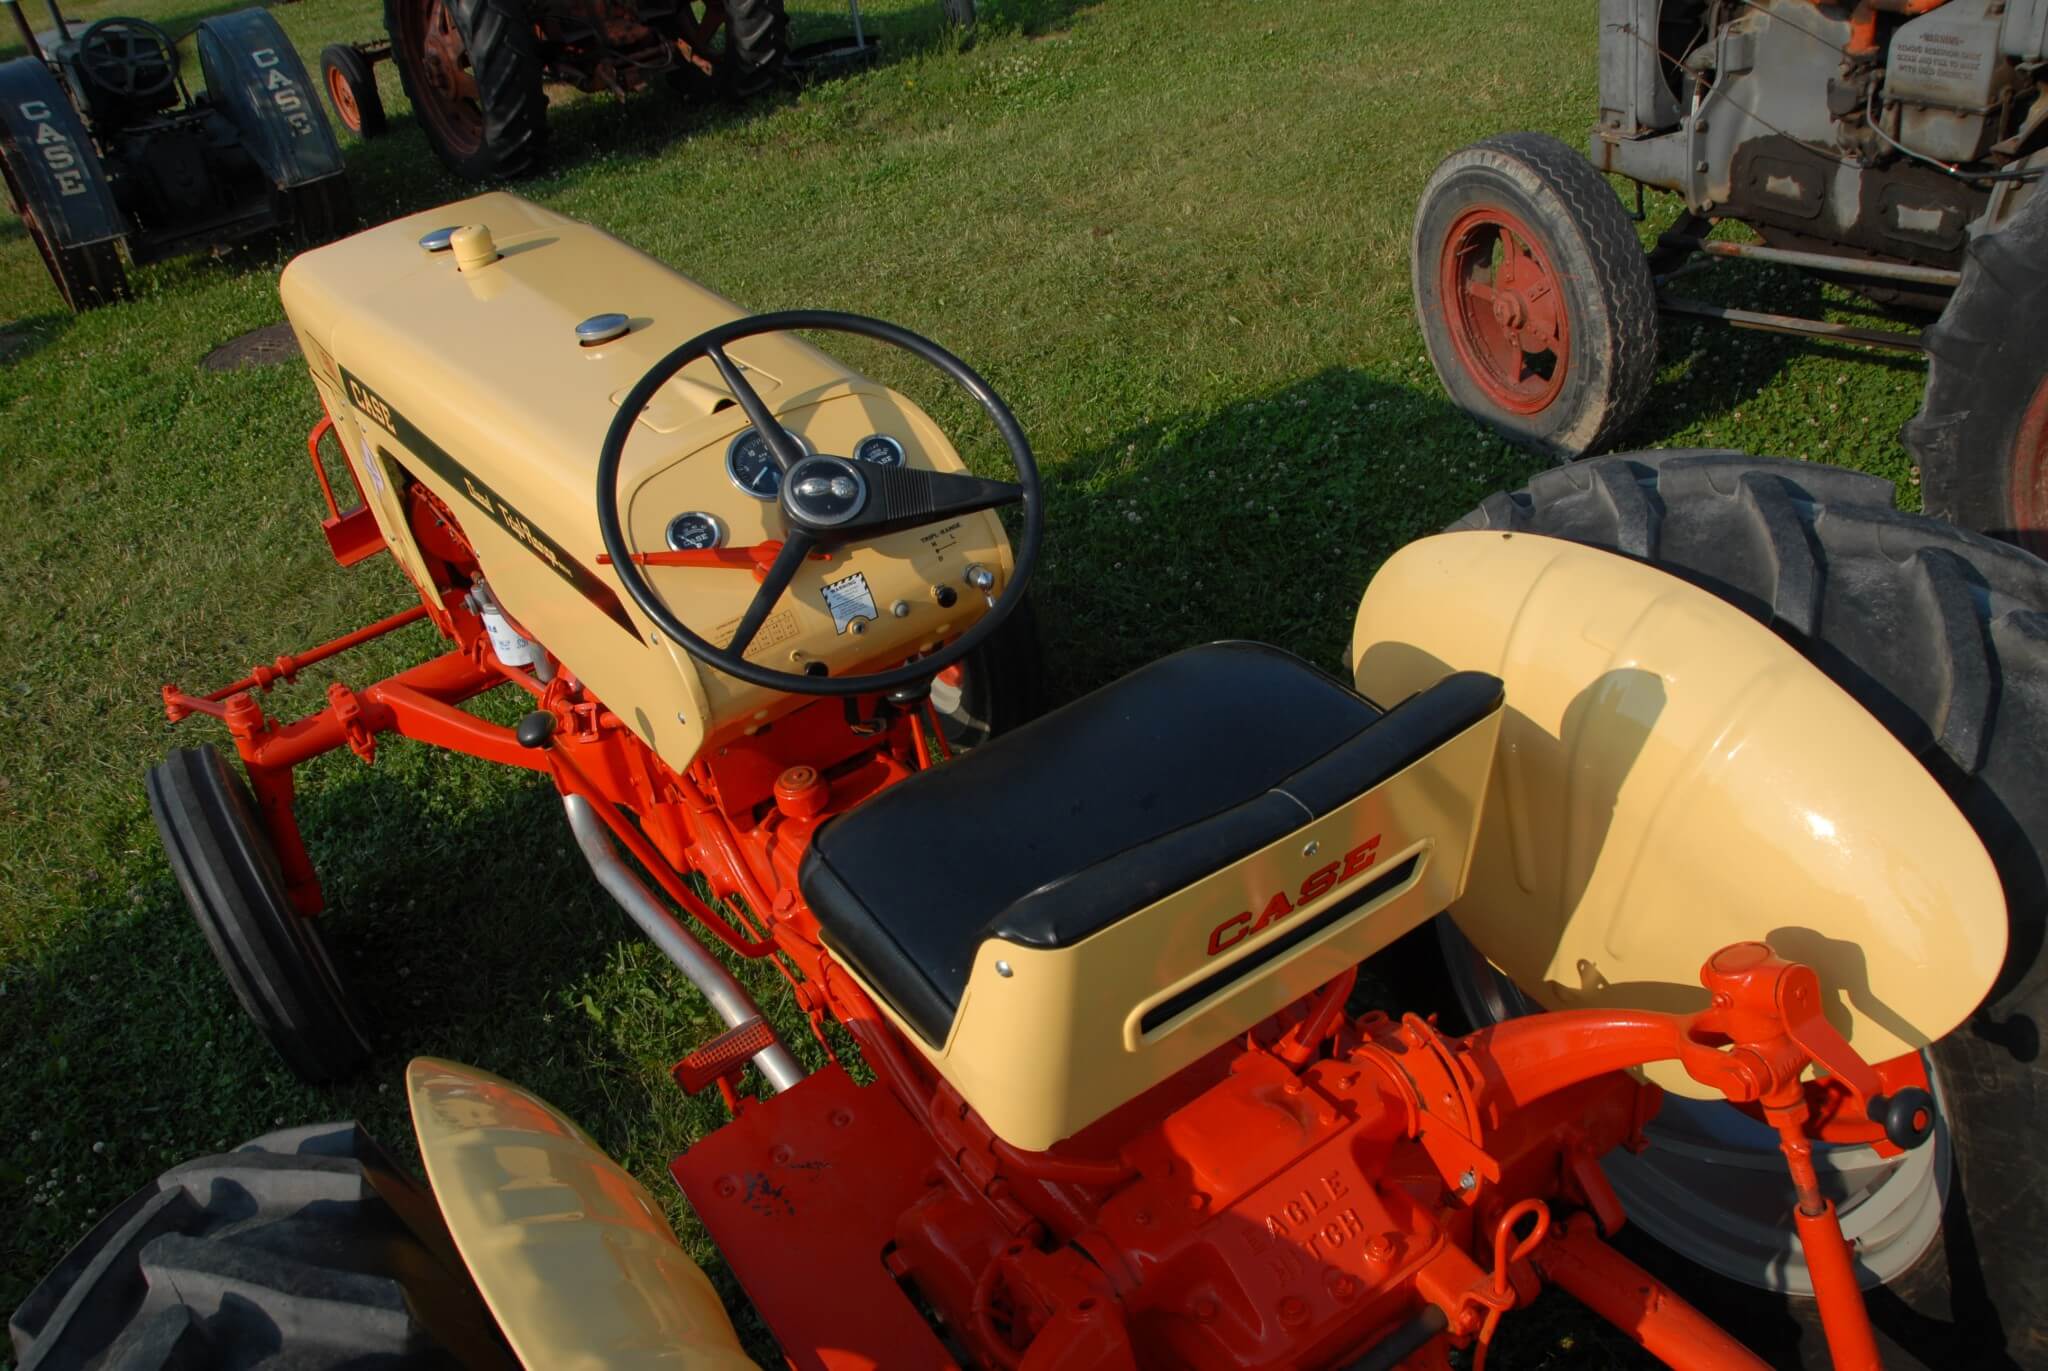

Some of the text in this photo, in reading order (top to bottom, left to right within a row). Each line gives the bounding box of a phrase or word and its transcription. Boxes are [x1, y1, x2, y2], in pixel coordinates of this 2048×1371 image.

[20, 100, 87, 196] CASE
[349, 379, 397, 436] CASE
[1207, 833, 1383, 957] CASE
[1241, 1169, 1350, 1257] EAGLE
